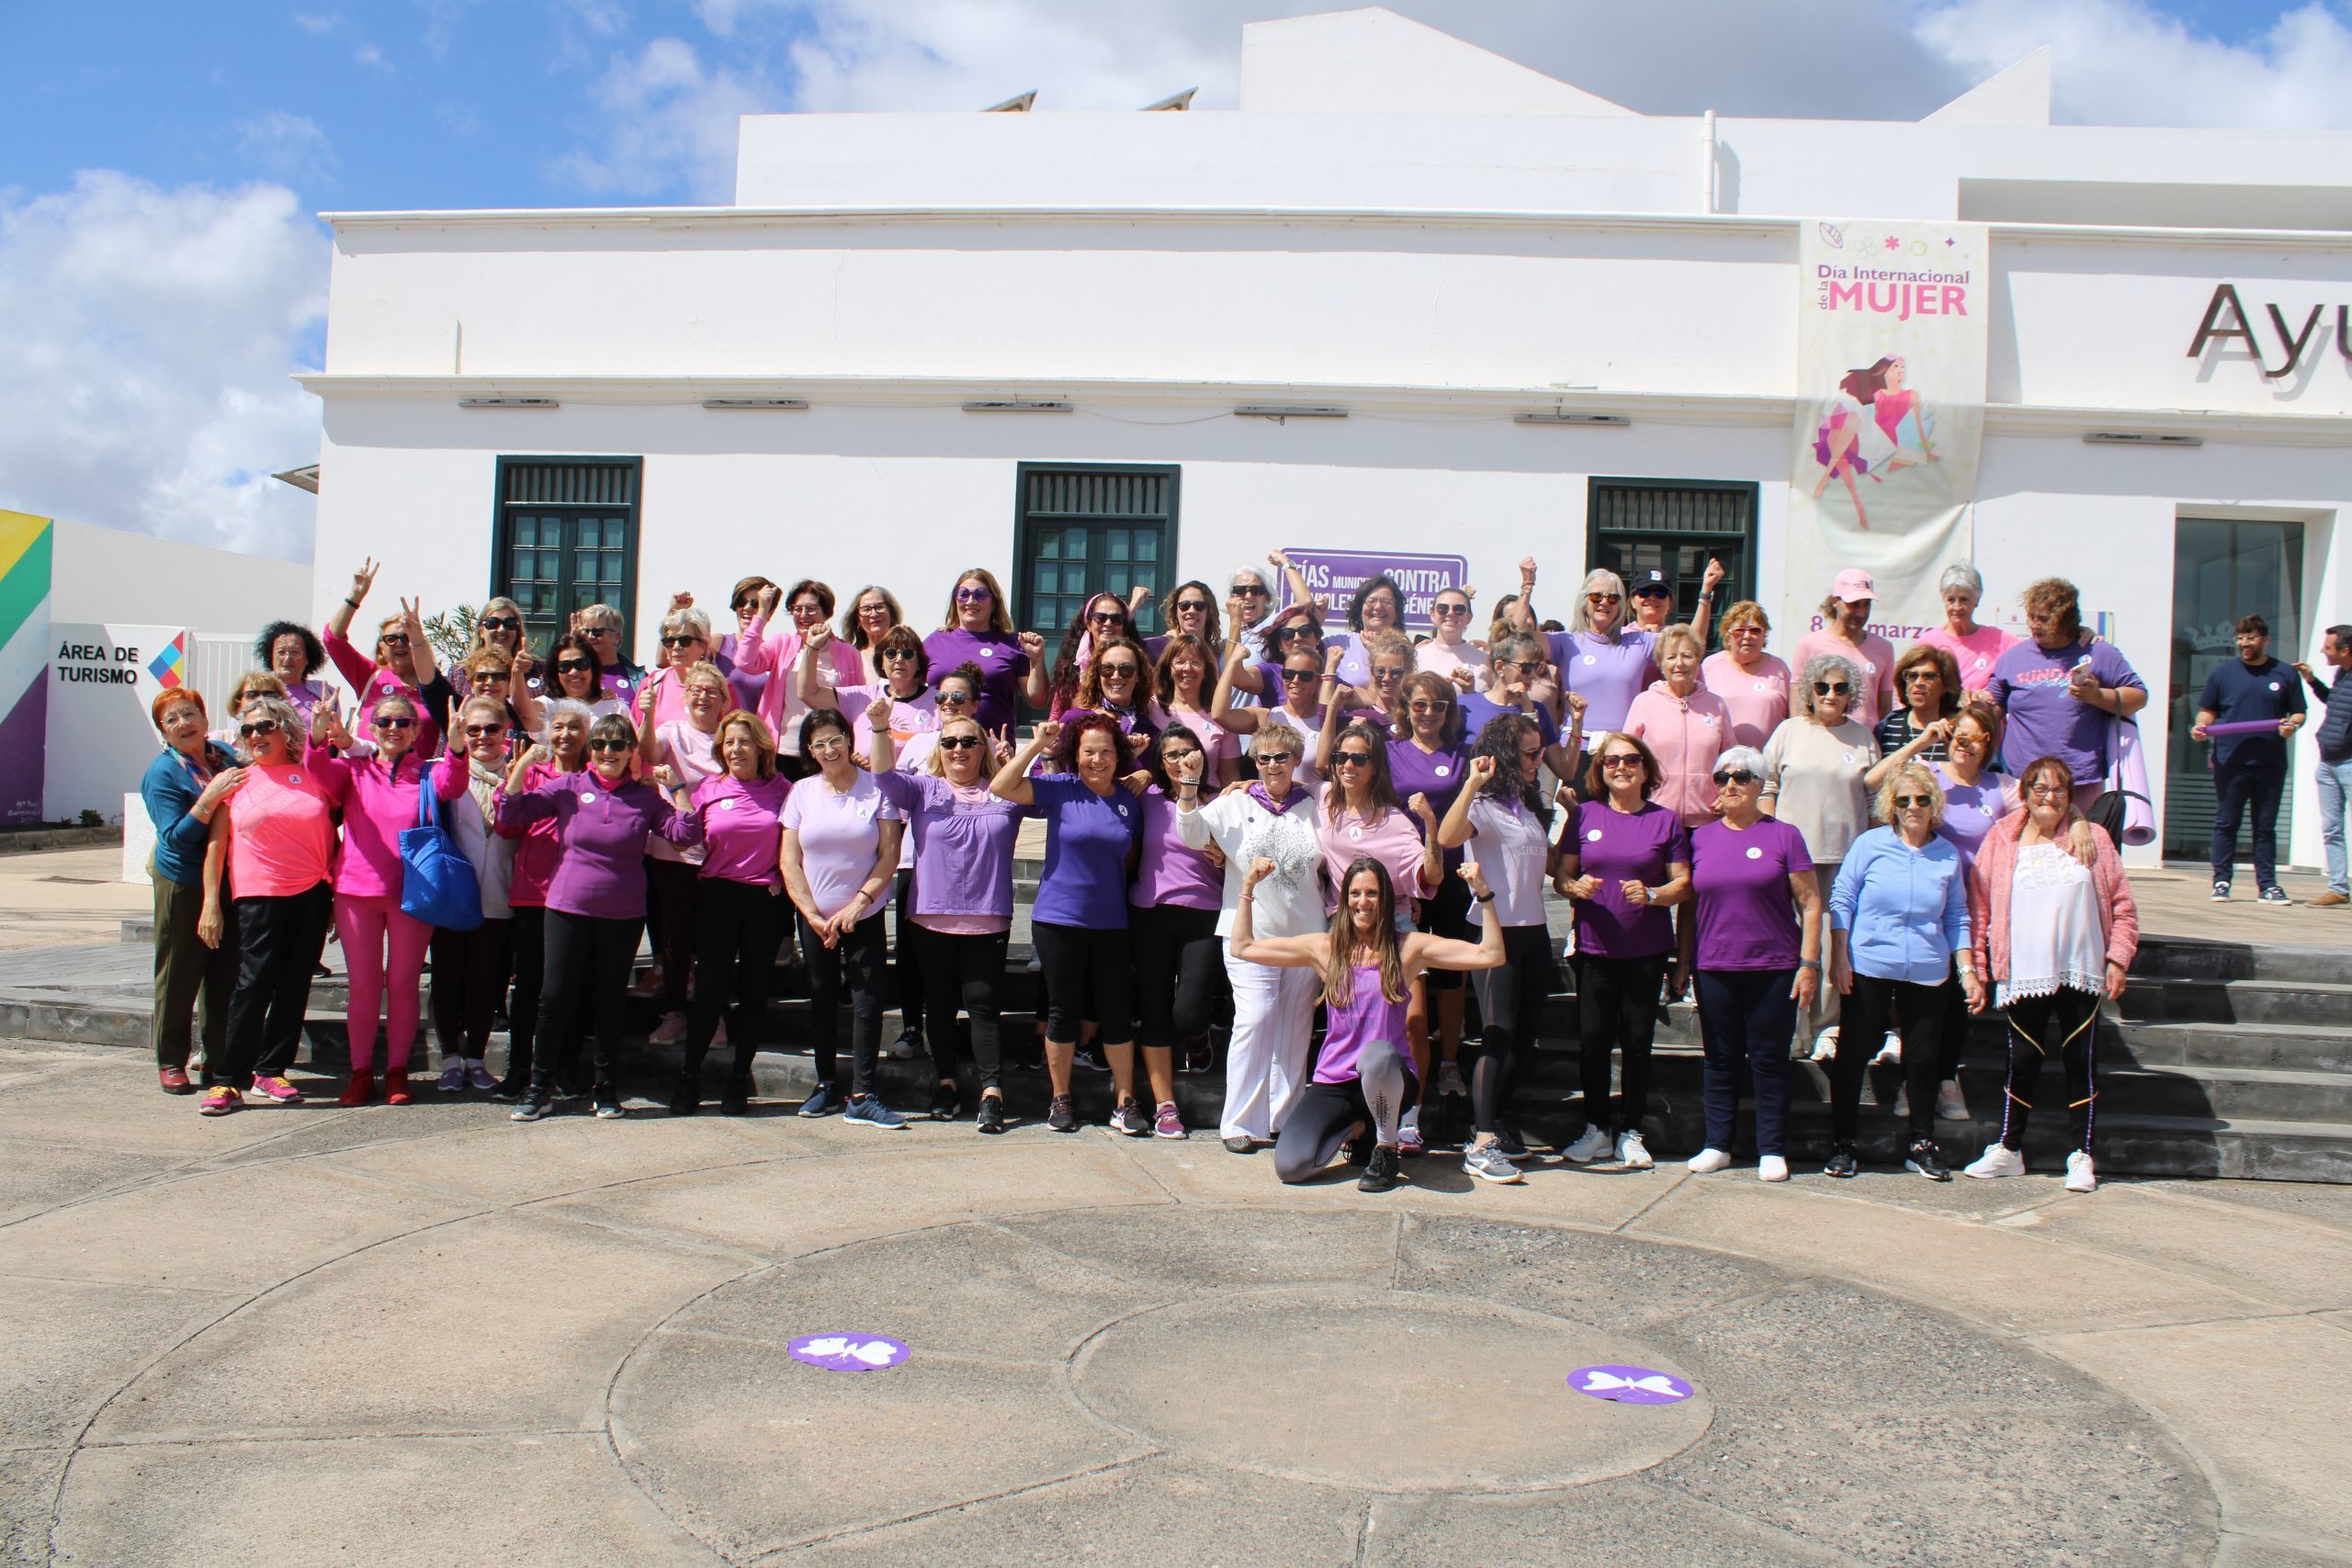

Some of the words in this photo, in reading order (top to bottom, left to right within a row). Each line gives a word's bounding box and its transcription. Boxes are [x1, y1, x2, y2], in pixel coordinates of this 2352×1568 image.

[1817, 265, 1847, 278] Día
[1853, 265, 1970, 284] Internacional
[1817, 280, 1828, 290] la
[1817, 294, 1828, 310] de
[1829, 281, 1968, 321] MUJER
[1332, 576, 1371, 590] MUNIC
[1403, 592, 1435, 615] GÉNE
[1810, 615, 1824, 632] 8
[58, 640, 106, 660] ÁREA
[115, 647, 139, 662] DE
[57, 666, 138, 684] TURISMO
